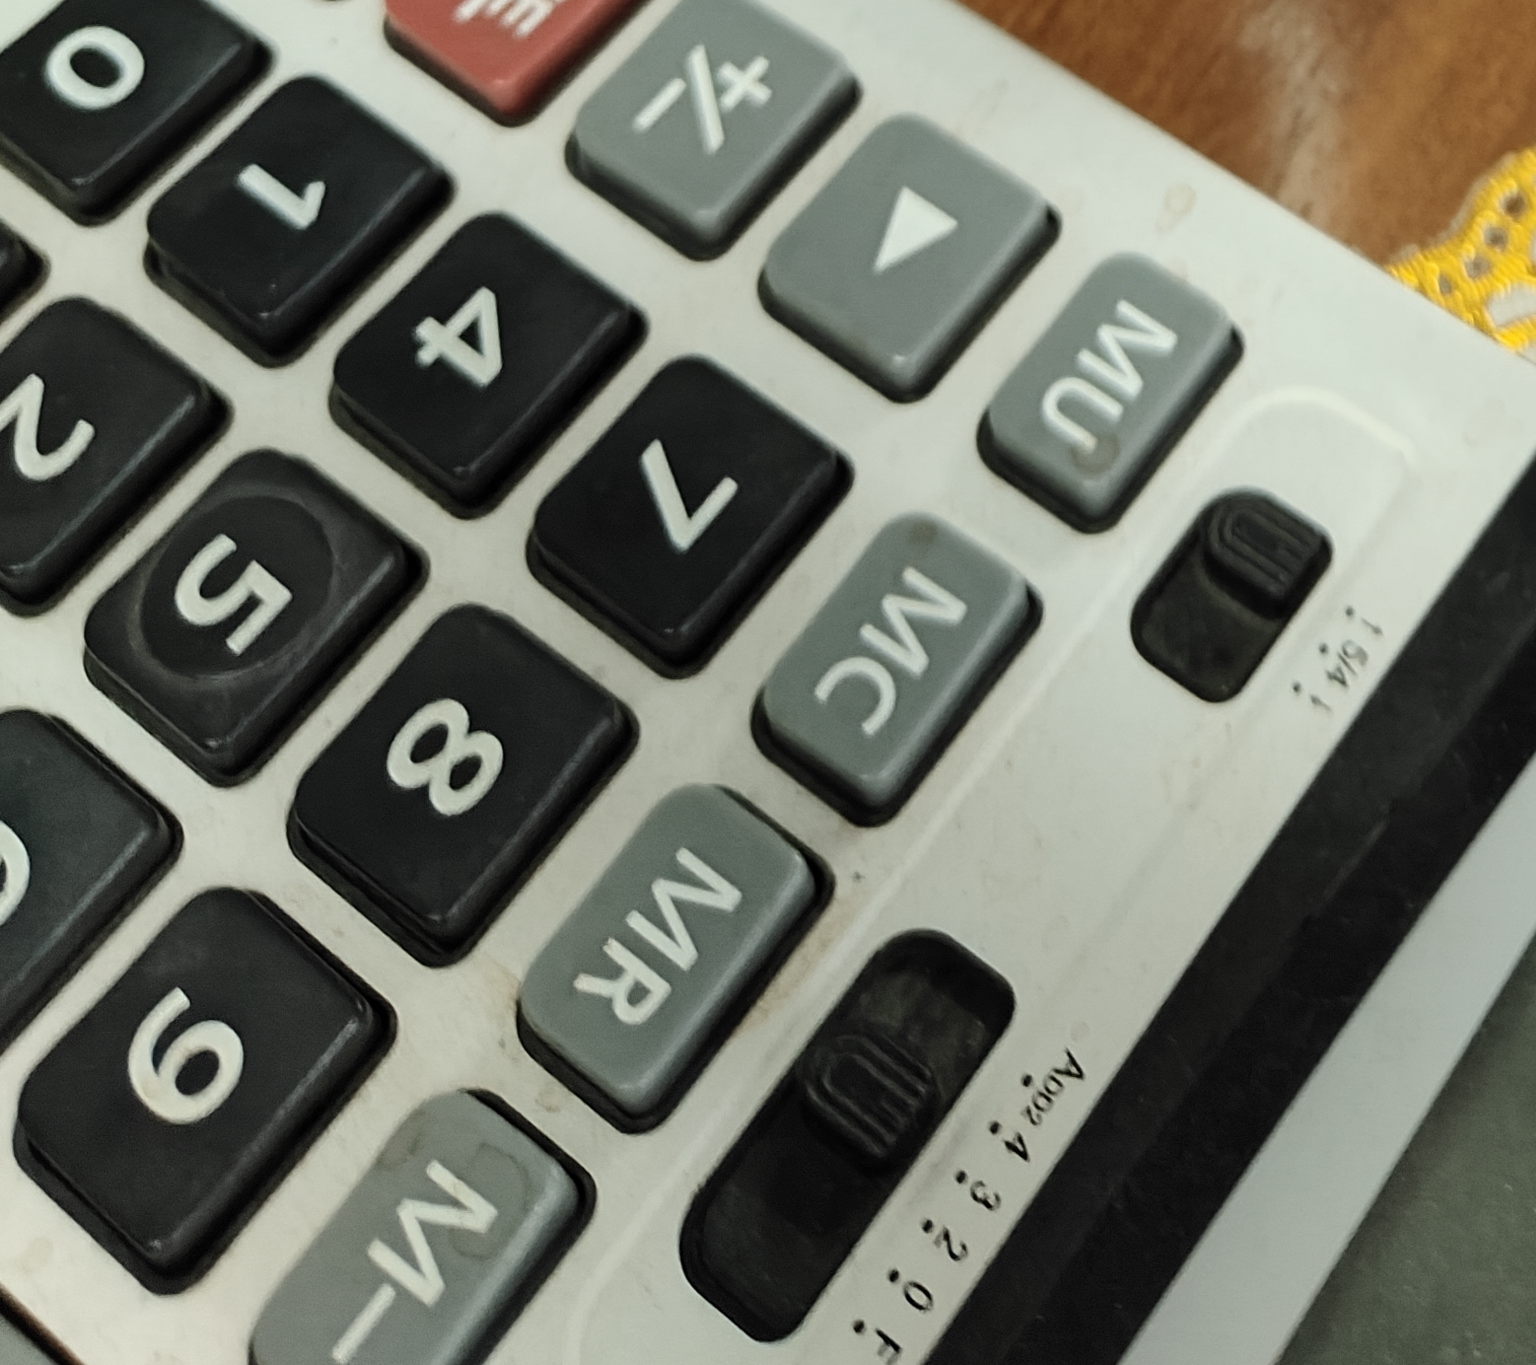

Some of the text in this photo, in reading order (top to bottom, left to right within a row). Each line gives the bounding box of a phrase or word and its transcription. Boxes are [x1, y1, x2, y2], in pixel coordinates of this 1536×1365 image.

[45, 25, 146, 110] 0
[236, 163, 326, 231] 1
[415, 286, 503, 388] 4
[1040, 298, 1178, 454] MU
[0, 374, 95, 481] 2
[641, 439, 738, 553] 7
[174, 533, 293, 657] 5
[813, 567, 968, 736] MC
[386, 697, 505, 817] 8
[573, 847, 742, 1026] MR
[127, 986, 245, 1125] 9
[934, 1227, 969, 1262] 2
[970, 1180, 1002, 1210] 3
[902, 1281, 934, 1312] 0
